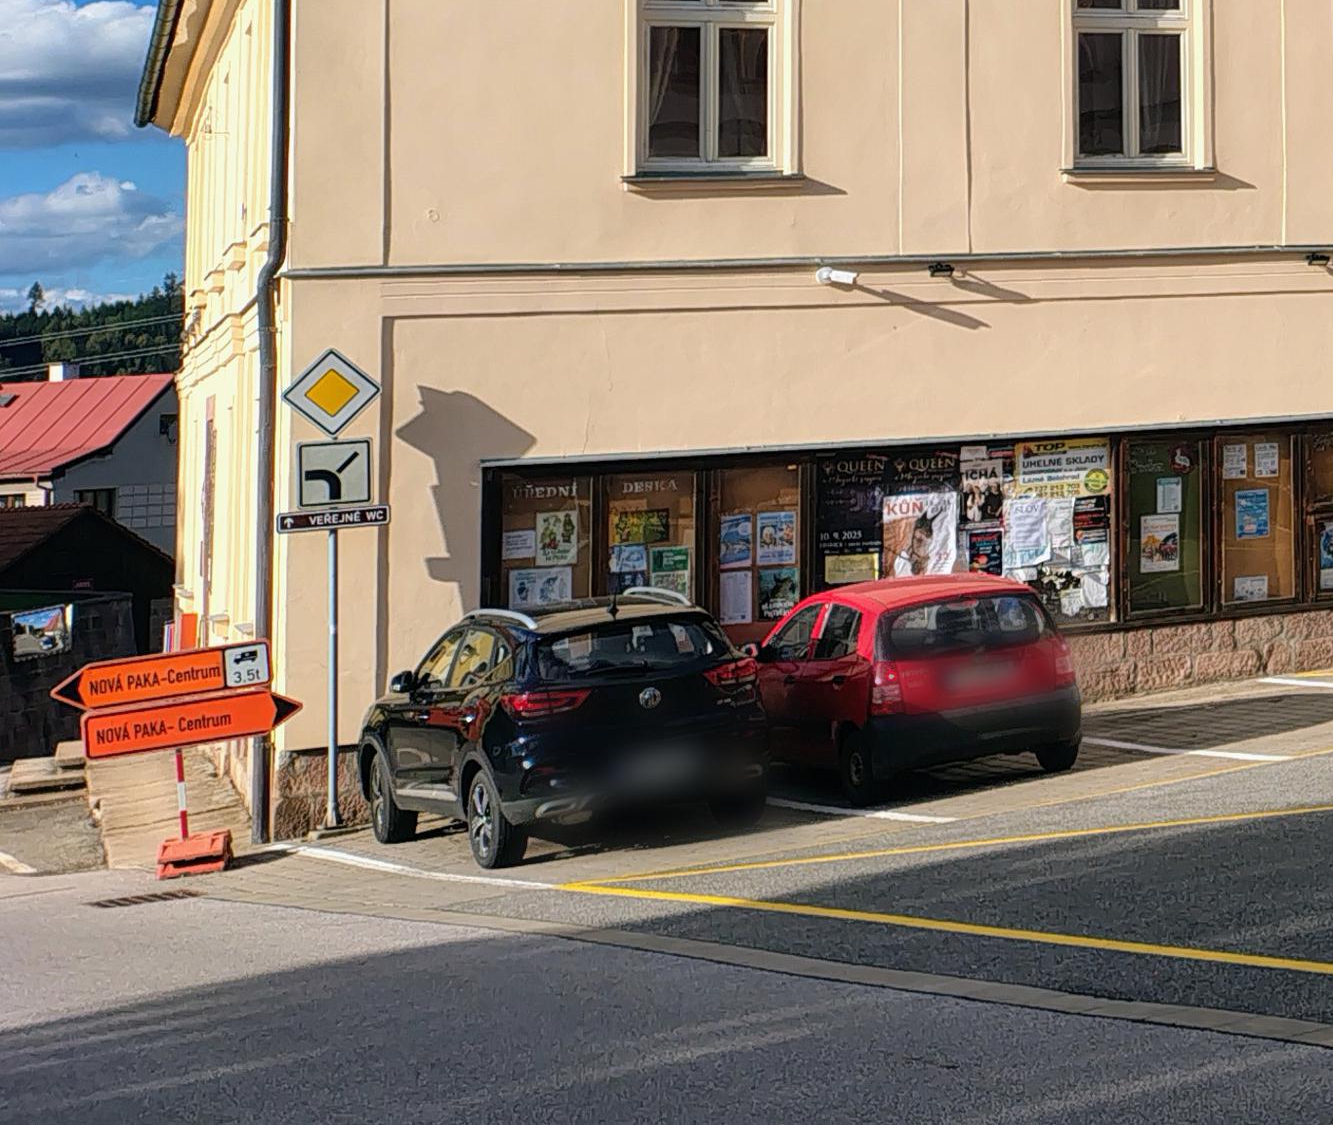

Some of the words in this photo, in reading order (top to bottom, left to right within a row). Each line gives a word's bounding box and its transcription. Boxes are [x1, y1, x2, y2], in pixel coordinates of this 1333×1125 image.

[1034, 443, 1066, 452] TOP
[837, 459, 885, 475] QUEEN
[910, 457, 956, 472] QUEEN
[1022, 457, 1062, 469] UHELNÉ
[1065, 454, 1105, 466] SKLADY
[622, 479, 679, 494] DESKA
[886, 499, 924, 516] KŮŇ
[308, 512, 361, 526] VEŘEJNÉ
[365, 510, 384, 521] WC
[89, 676, 122, 696] NOVÁ
[96, 724, 131, 744] NOVÁ
[178, 713, 232, 733] Centrum
